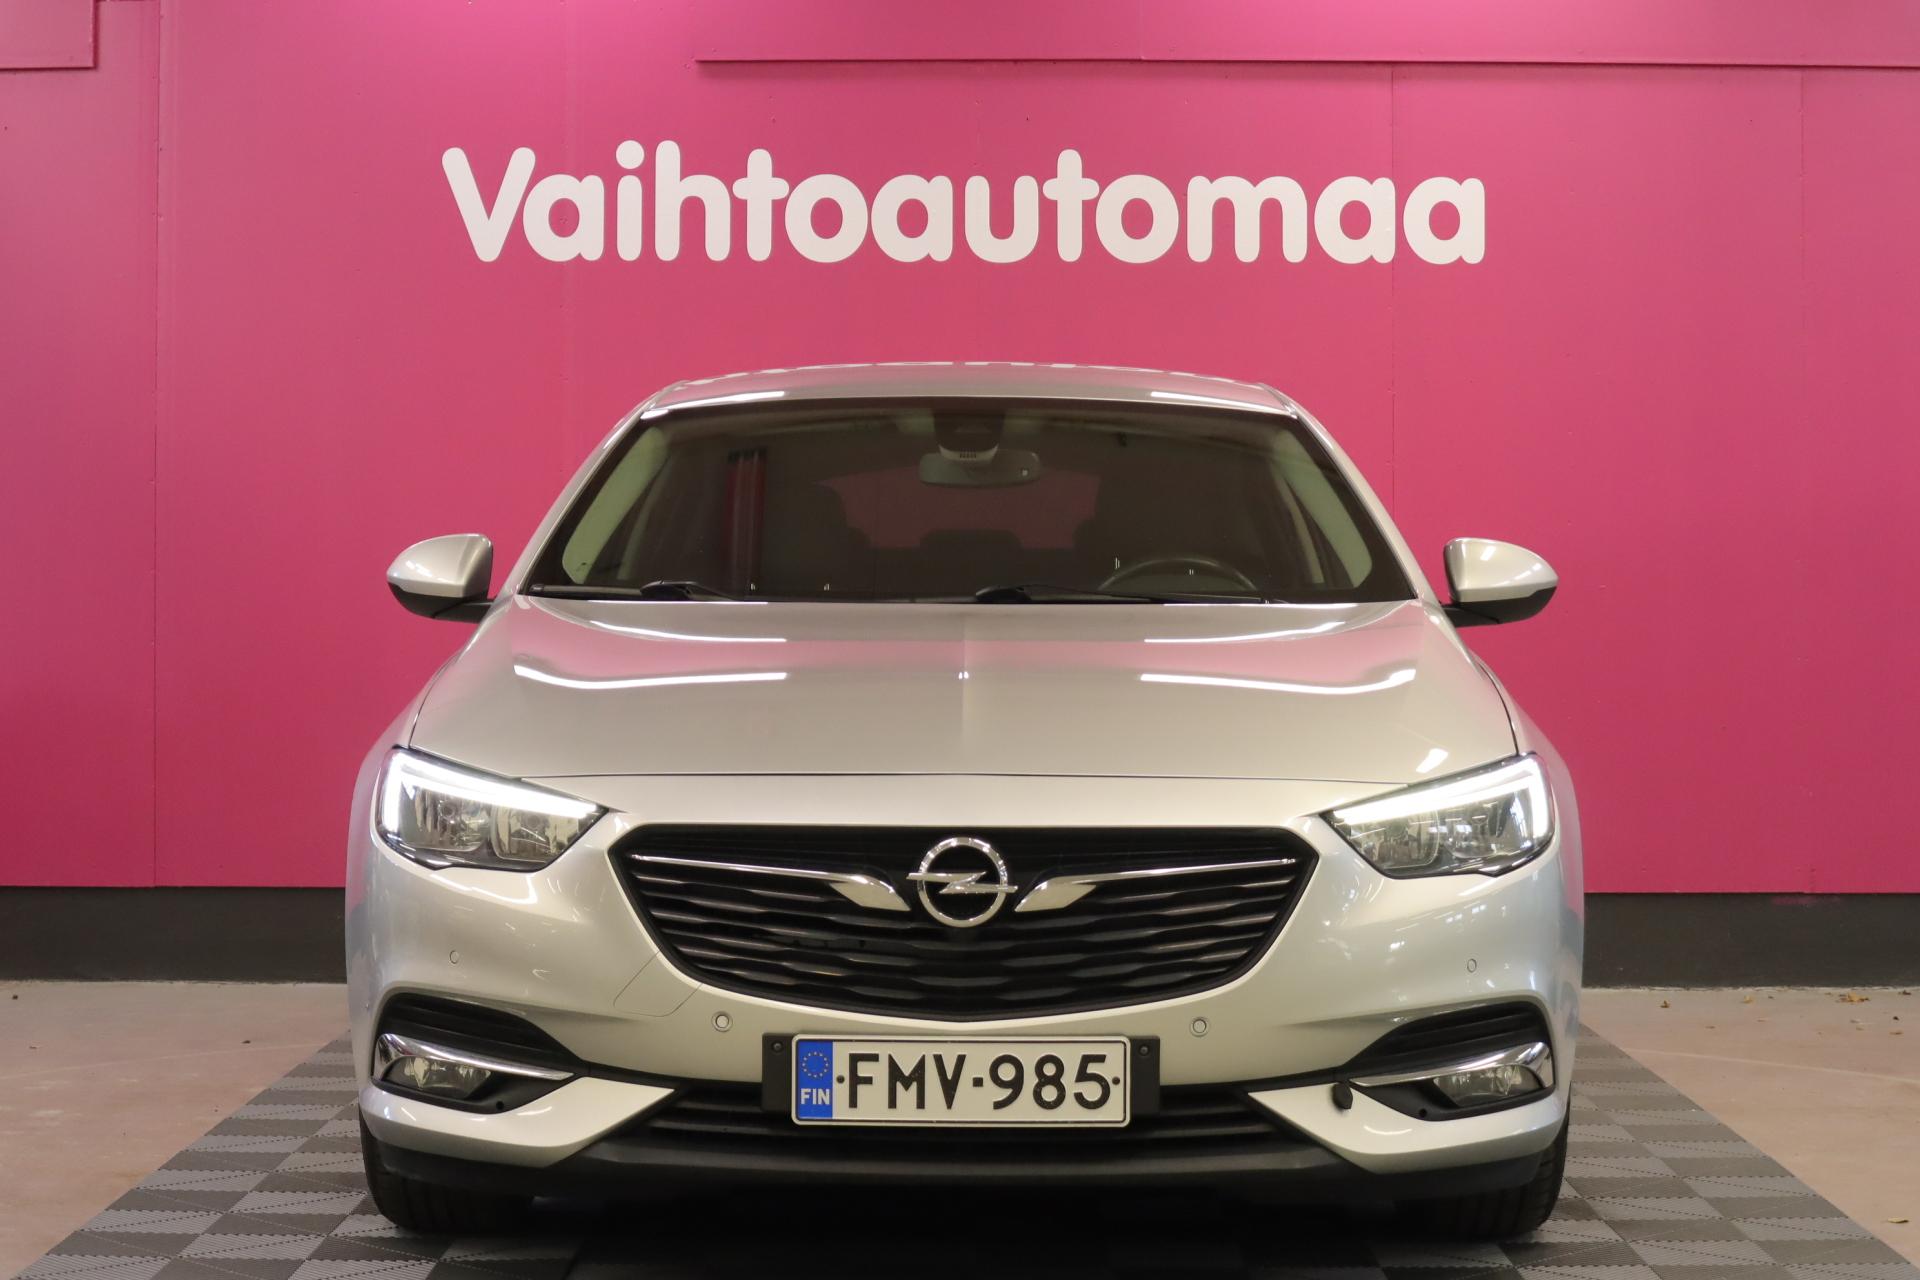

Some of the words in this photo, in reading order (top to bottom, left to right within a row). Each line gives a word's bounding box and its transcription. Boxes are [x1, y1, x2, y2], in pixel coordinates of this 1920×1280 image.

[442, 139, 1486, 265] Vaihtoautomaa
[800, 1088, 830, 1105] FIN
[848, 1052, 1111, 1110] FMV-985
